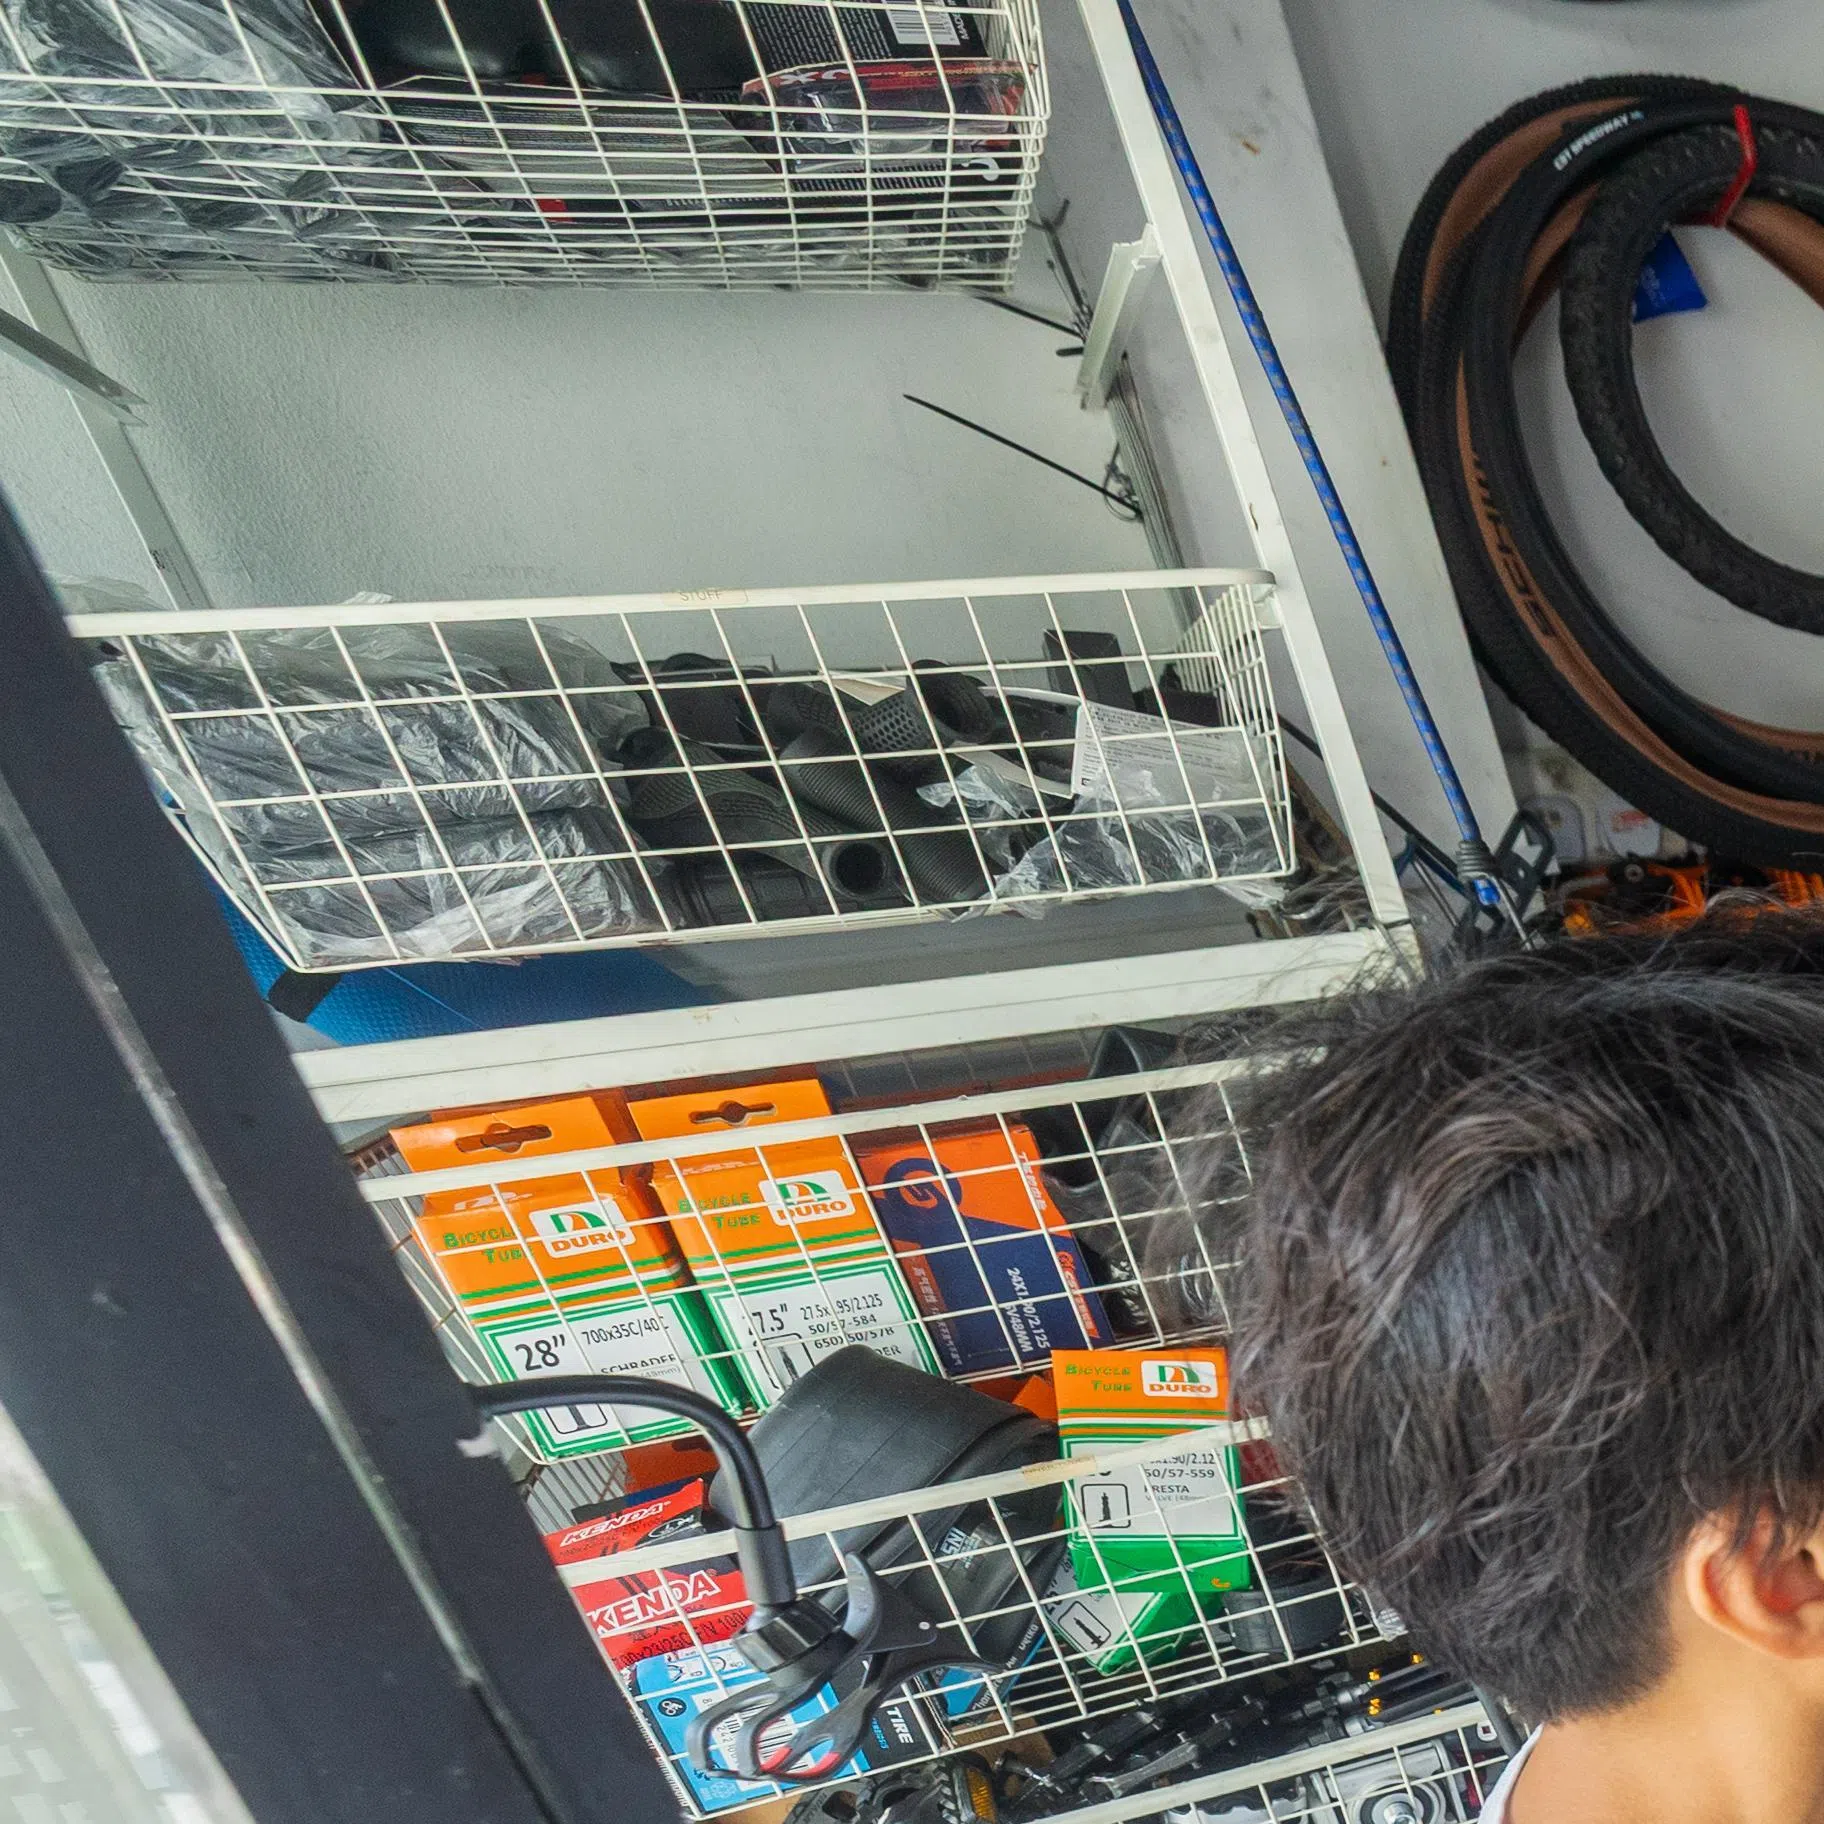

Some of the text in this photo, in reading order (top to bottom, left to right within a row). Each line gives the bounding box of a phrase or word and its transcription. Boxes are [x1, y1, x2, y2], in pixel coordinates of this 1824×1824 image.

[711, 1213, 762, 1230] TUBE
[776, 1199, 848, 1222] DURO
[549, 1230, 627, 1254] DURO
[744, 1301, 790, 1338] 7.5"
[799, 1291, 884, 1322] 27.5x.95/2.125
[1065, 1364, 1132, 1378] BICYCLE
[1091, 1379, 1133, 1393] TUBE
[1148, 1382, 1213, 1395] DURO
[558, 1501, 666, 1547] KENDA
[940, 1527, 969, 1555] SNI
[585, 1570, 721, 1637] KENDA
[885, 1706, 915, 1745] TIRE
